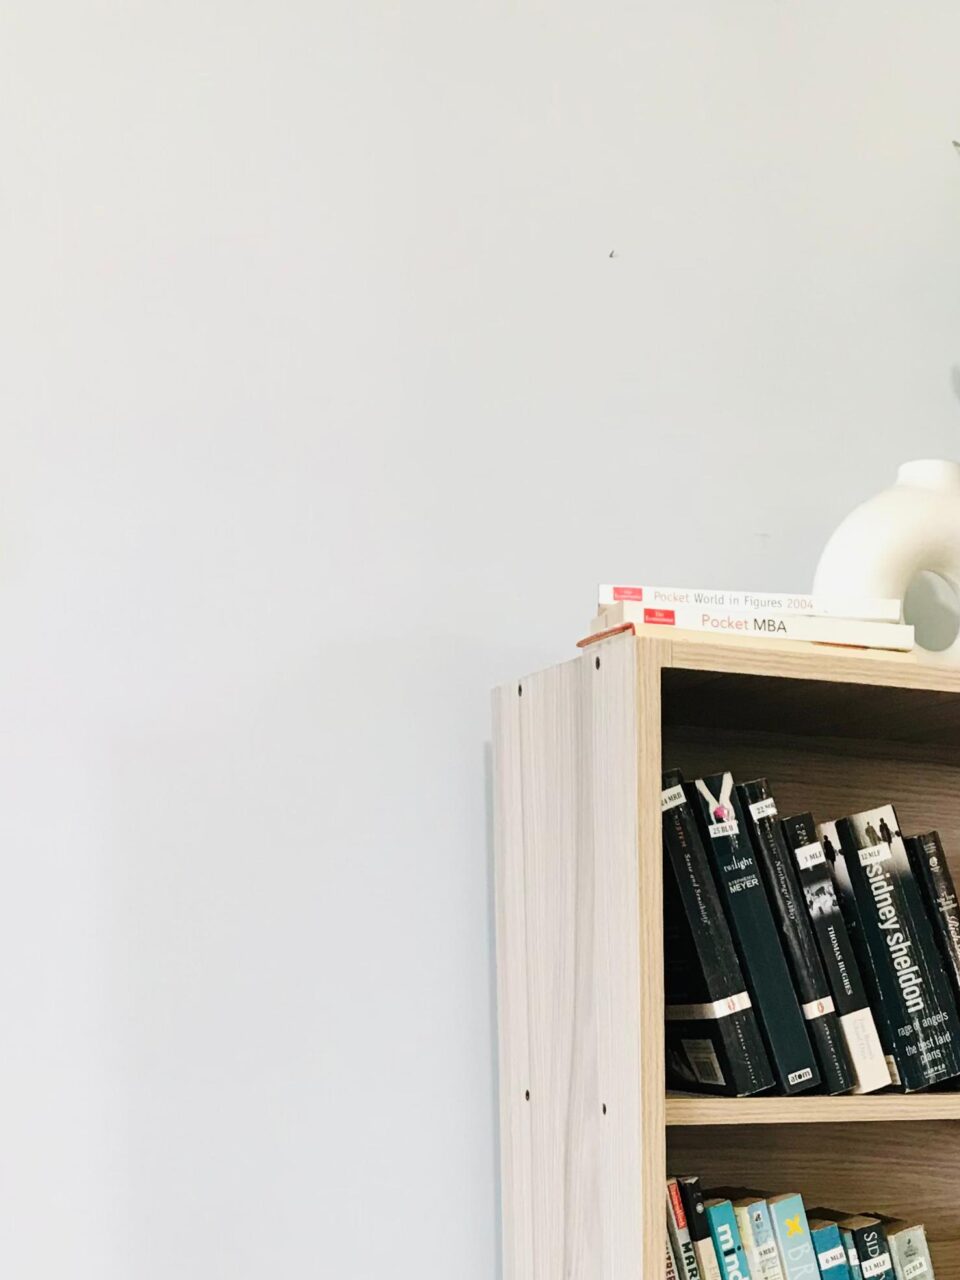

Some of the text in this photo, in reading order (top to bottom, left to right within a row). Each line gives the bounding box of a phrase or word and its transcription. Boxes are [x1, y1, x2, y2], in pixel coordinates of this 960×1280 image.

[654, 591, 689, 603] Pocket
[694, 592, 724, 605] World
[729, 594, 739, 605] in
[744, 595, 782, 609] Figures
[787, 598, 813, 609] 2004
[701, 614, 787, 633] Pocket MBA
[723, 855, 753, 873] twilight
[729, 878, 759, 894] MEYER
[866, 862, 924, 1013] sidney sheldon
[827, 925, 853, 996] THOMAS HUGHES
[898, 1024, 913, 1037] rage
[922, 1011, 949, 1028] angels
[905, 1031, 952, 1056] the best laid
[920, 1049, 942, 1066] plans
[790, 1069, 811, 1083] atom
